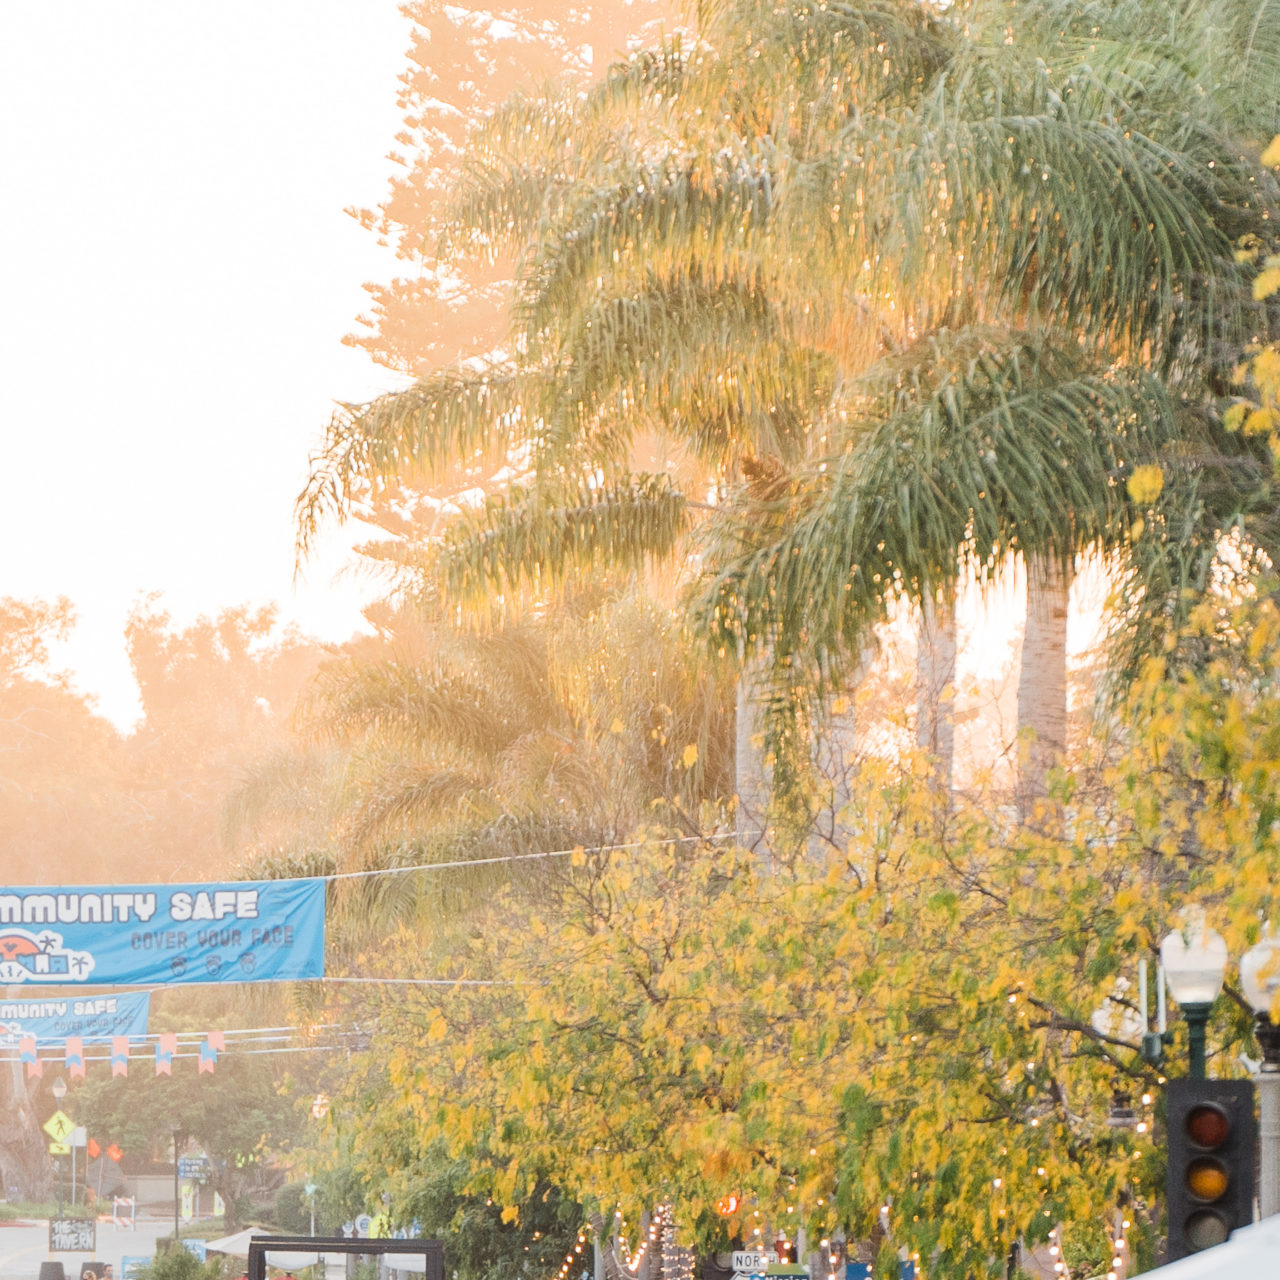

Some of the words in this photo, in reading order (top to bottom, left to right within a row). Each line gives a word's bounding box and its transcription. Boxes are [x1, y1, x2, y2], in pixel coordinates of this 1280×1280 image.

[170, 890, 259, 921] SAFE
[131, 931, 189, 950] COVER
[197, 928, 242, 948] YOUR
[251, 925, 294, 946] FACE
[73, 999, 117, 1015] SAFE
[736, 1255, 776, 1267] NORH
